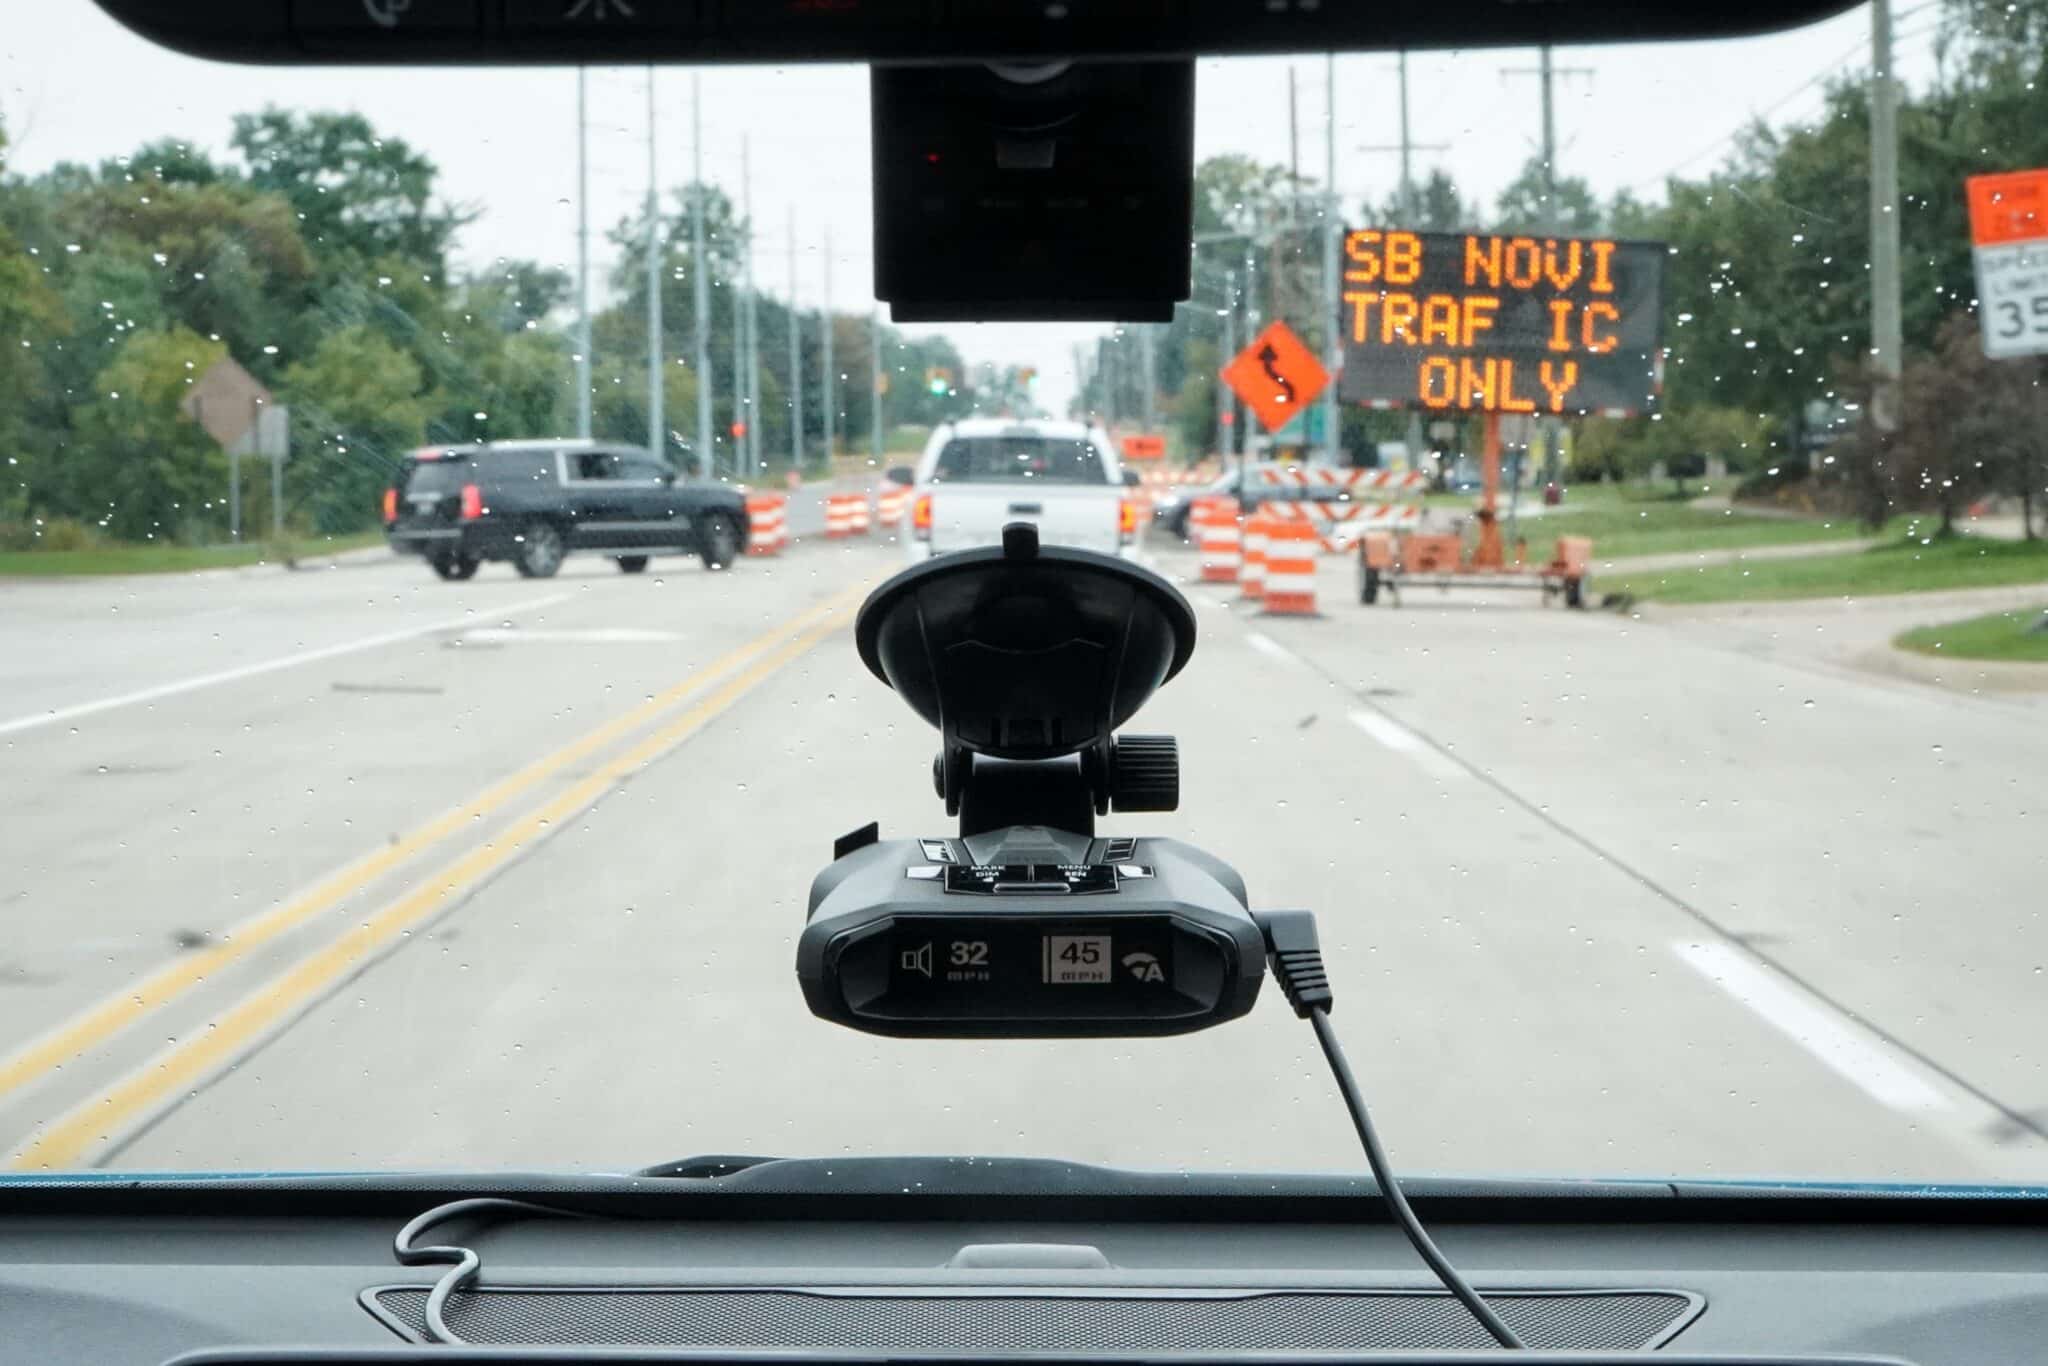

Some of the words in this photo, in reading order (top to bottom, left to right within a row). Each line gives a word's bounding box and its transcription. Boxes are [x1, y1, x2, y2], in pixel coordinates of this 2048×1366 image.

[1344, 230, 1423, 285] SB
[1464, 235, 1616, 293] NOVI
[1997, 295, 2048, 339] 35
[1419, 355, 1578, 413] ONLY
[950, 940, 989, 965] 32
[1060, 942, 1099, 965] 45
